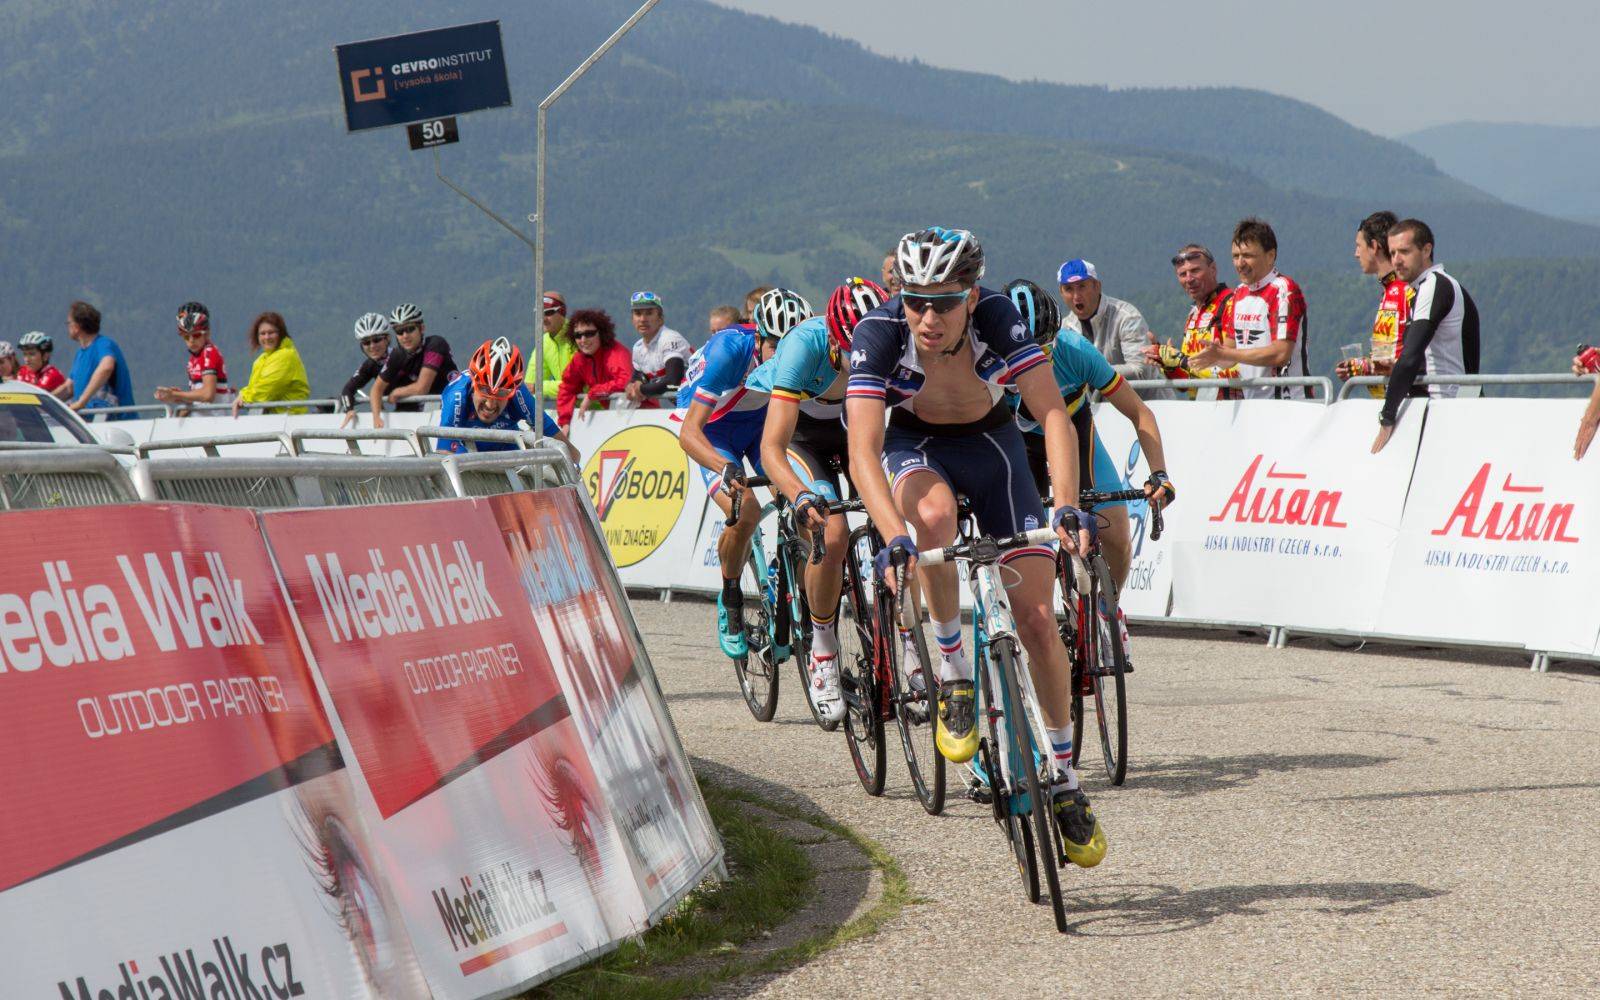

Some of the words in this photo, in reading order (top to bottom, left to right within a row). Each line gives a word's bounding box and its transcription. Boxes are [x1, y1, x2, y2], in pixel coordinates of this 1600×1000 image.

[391, 49, 492, 75] CEVROINSTITUT
[422, 120, 444, 140] 50
[1209, 454, 1347, 528] Aisan
[1431, 463, 1579, 543] Aisan
[1204, 535, 1228, 550] AISAN
[1231, 536, 1276, 551] INDUSTRY
[1279, 538, 1311, 555] CZECH
[1314, 543, 1342, 558] s.r.o.
[1424, 549, 1452, 567] AISAN
[1455, 552, 1509, 571] INDUSTRY
[1510, 555, 1541, 573] CZECH
[1542, 560, 1570, 574] s.r.o.
[0, 561, 135, 674] edia
[117, 552, 264, 652] Walk
[305, 547, 423, 643] Media
[403, 541, 502, 627] Walk
[403, 653, 467, 695] OUTDOOR
[461, 643, 524, 684] PARTNER
[77, 683, 206, 738] OUTDOOR
[203, 676, 289, 718] PARTNER
[431, 862, 558, 952] MediaWalk.cz
[58, 936, 305, 1000] diaWalk.cz
